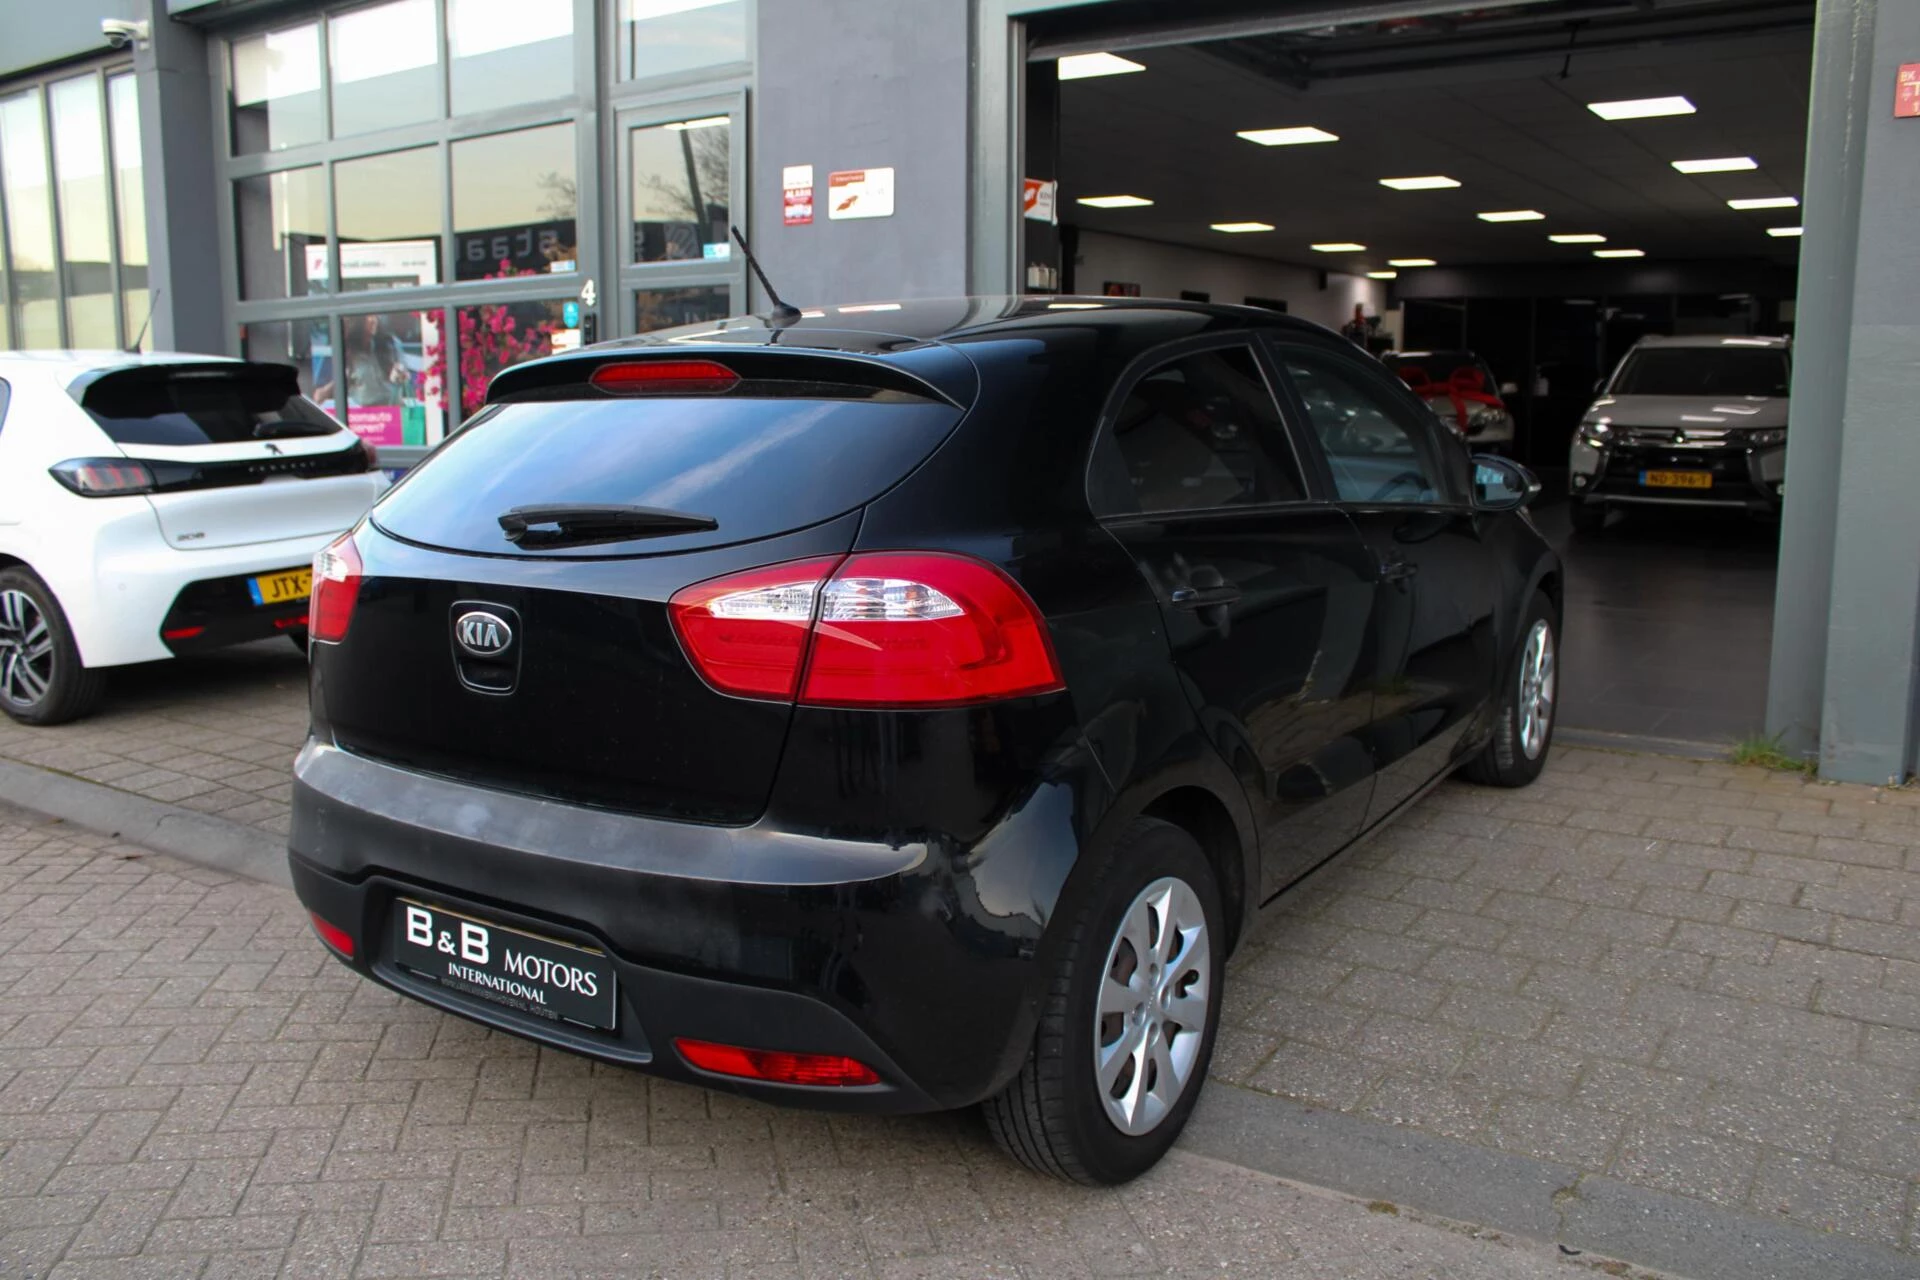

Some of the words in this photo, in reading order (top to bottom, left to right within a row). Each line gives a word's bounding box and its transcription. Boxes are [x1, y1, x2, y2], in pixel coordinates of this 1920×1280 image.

[581, 279, 596, 306] 4
[462, 620, 501, 648] KIA
[448, 962, 547, 1005] INTERNATIONAL
[504, 948, 598, 997] MOTORS
